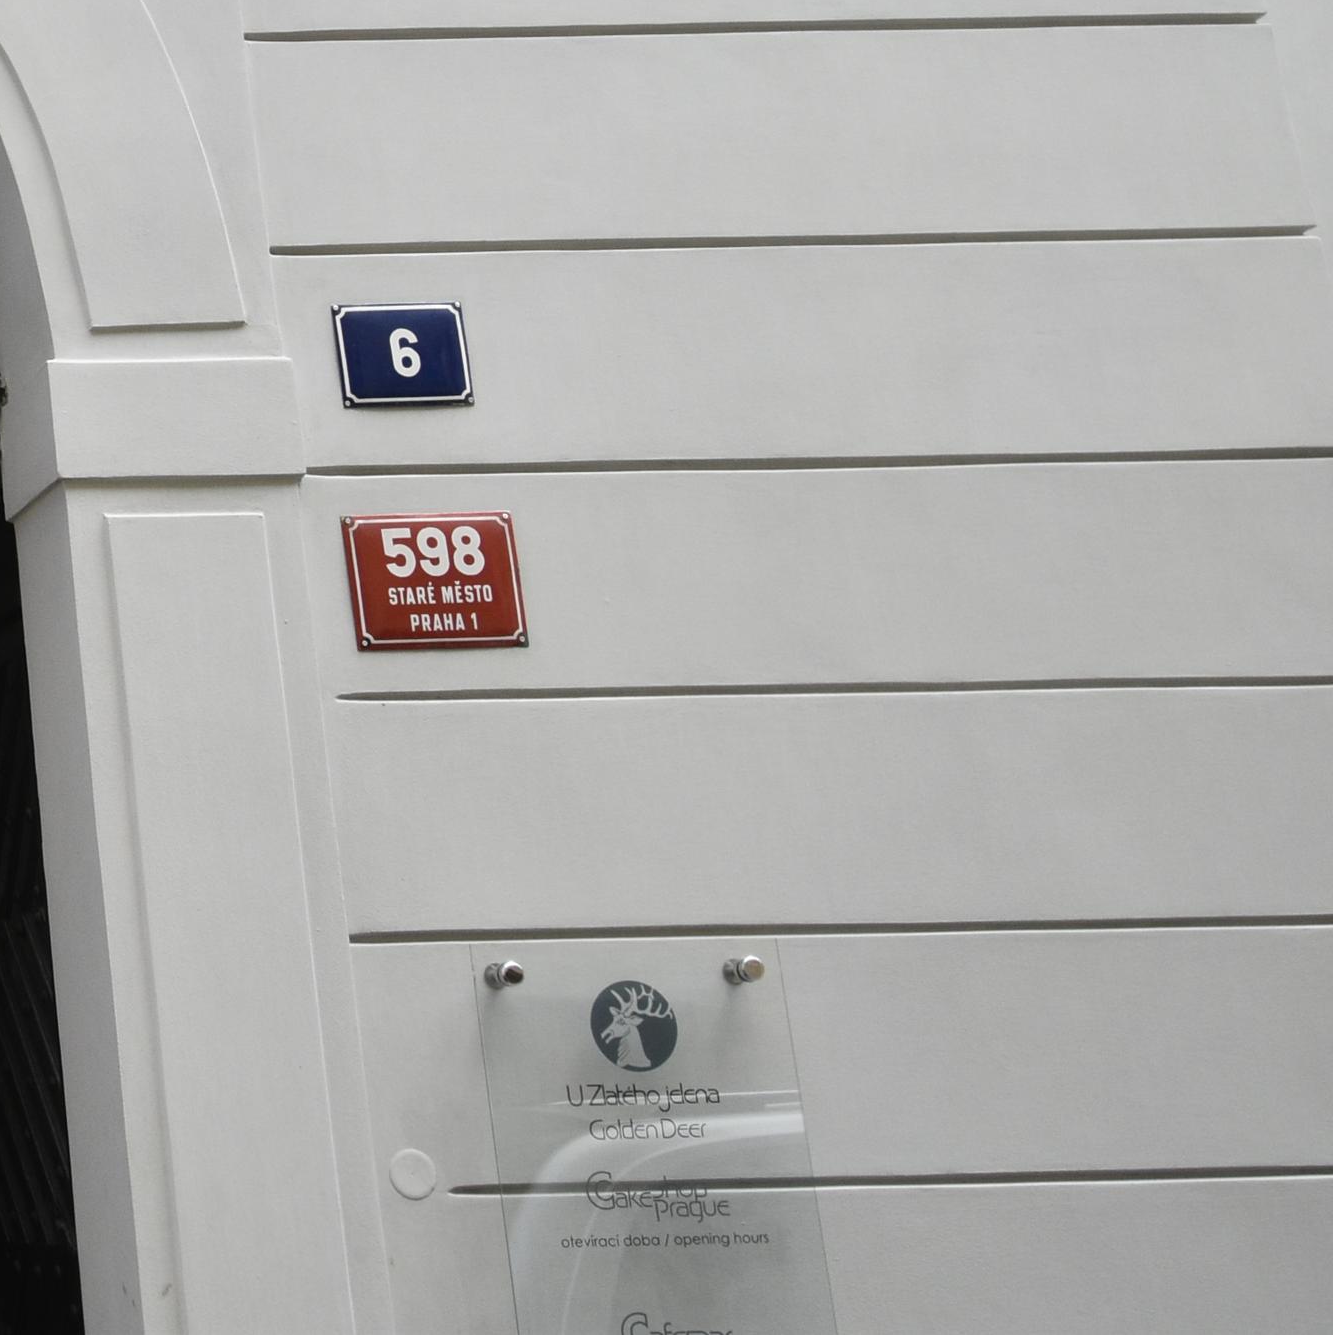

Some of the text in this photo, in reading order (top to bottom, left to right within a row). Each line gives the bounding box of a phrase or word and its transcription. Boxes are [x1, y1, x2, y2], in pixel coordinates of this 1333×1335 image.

[389, 328, 421, 377] 6
[381, 526, 485, 577] 598
[388, 580, 493, 605] STARÉ MĚSTO
[410, 612, 478, 632] PRAHA 1
[566, 1084, 583, 1107] U
[659, 1082, 720, 1112] jelena
[589, 1118, 706, 1140] Golden Deer
[624, 1233, 660, 1246] doba
[674, 1233, 730, 1248] opening
[733, 1232, 769, 1244] hours
